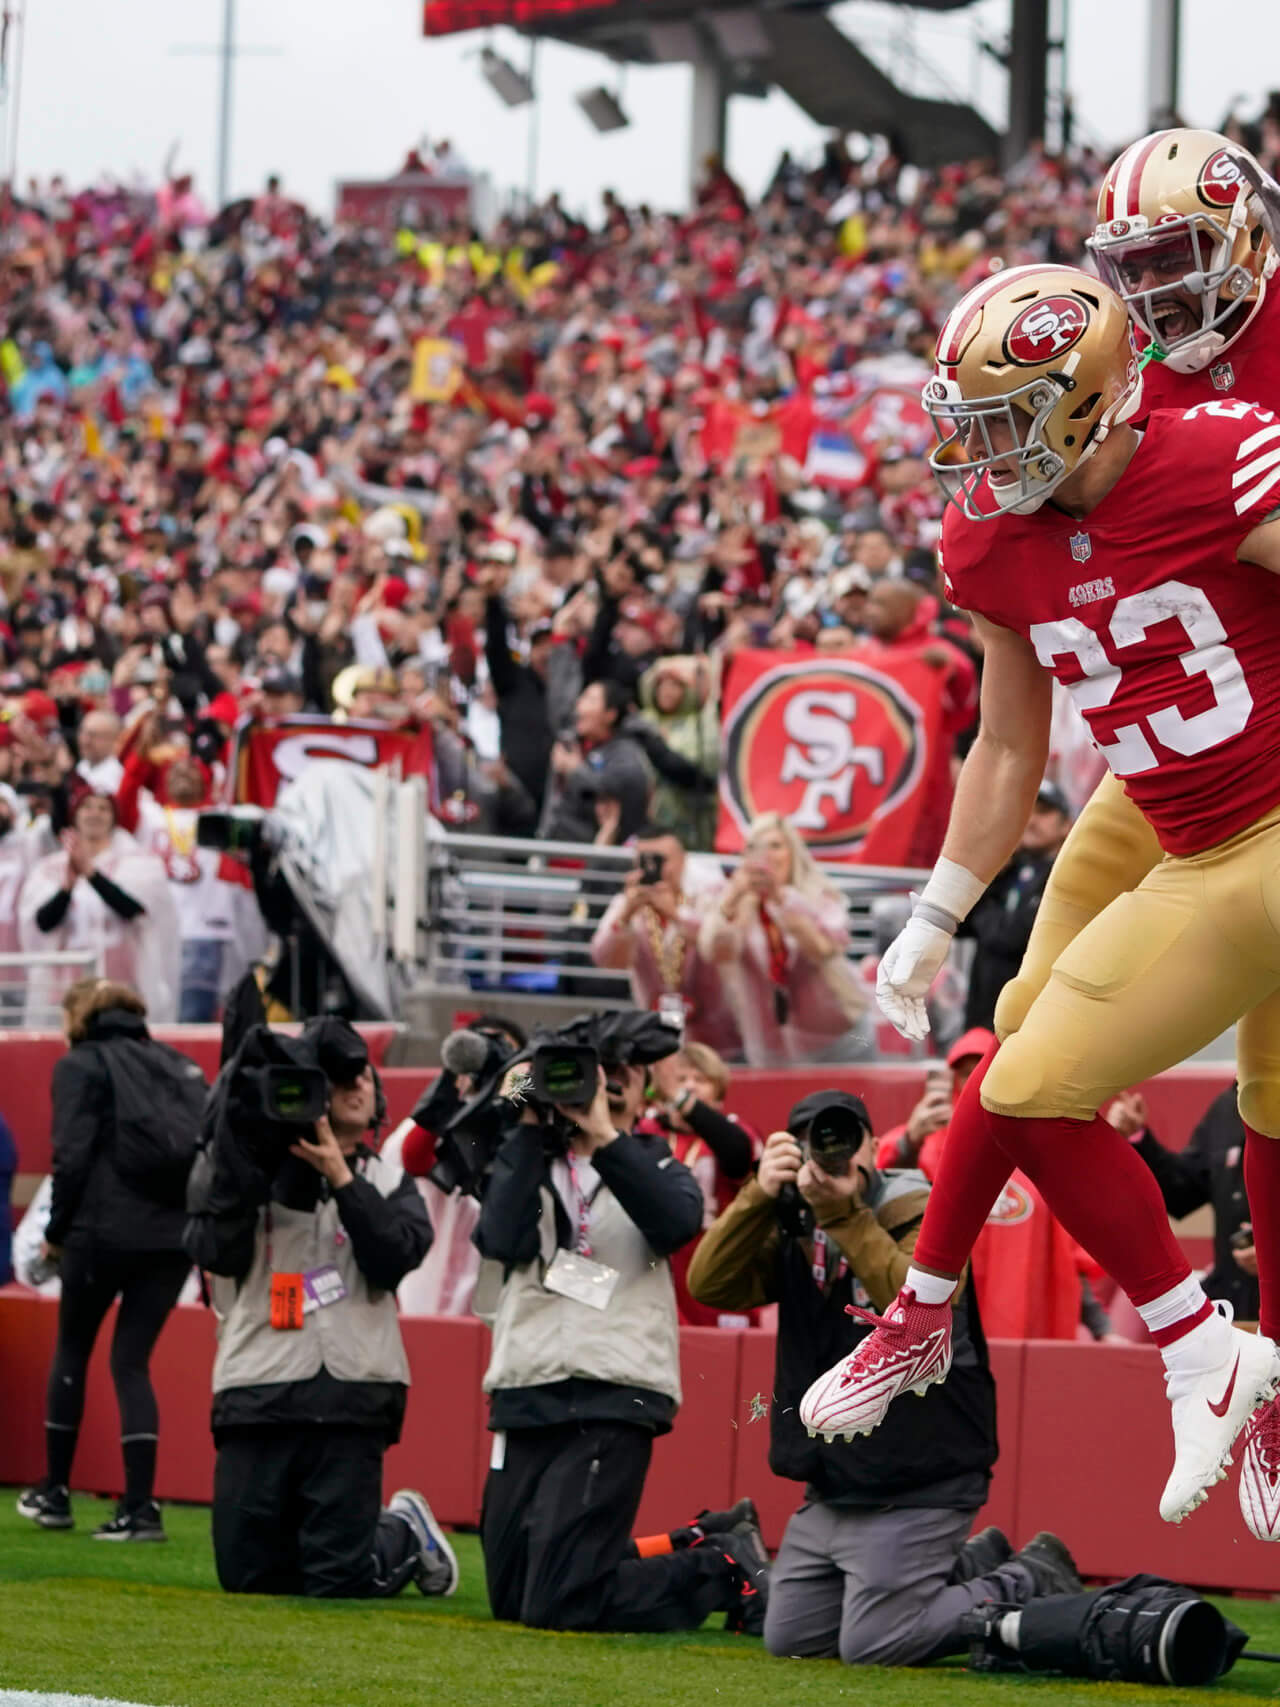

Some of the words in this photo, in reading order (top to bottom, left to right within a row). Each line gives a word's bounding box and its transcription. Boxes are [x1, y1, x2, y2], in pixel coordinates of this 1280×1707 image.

[1021, 304, 1077, 353] SF
[1068, 576, 1115, 608] 49ERS
[1030, 580, 1254, 775] 23
[780, 689, 885, 830] SF
